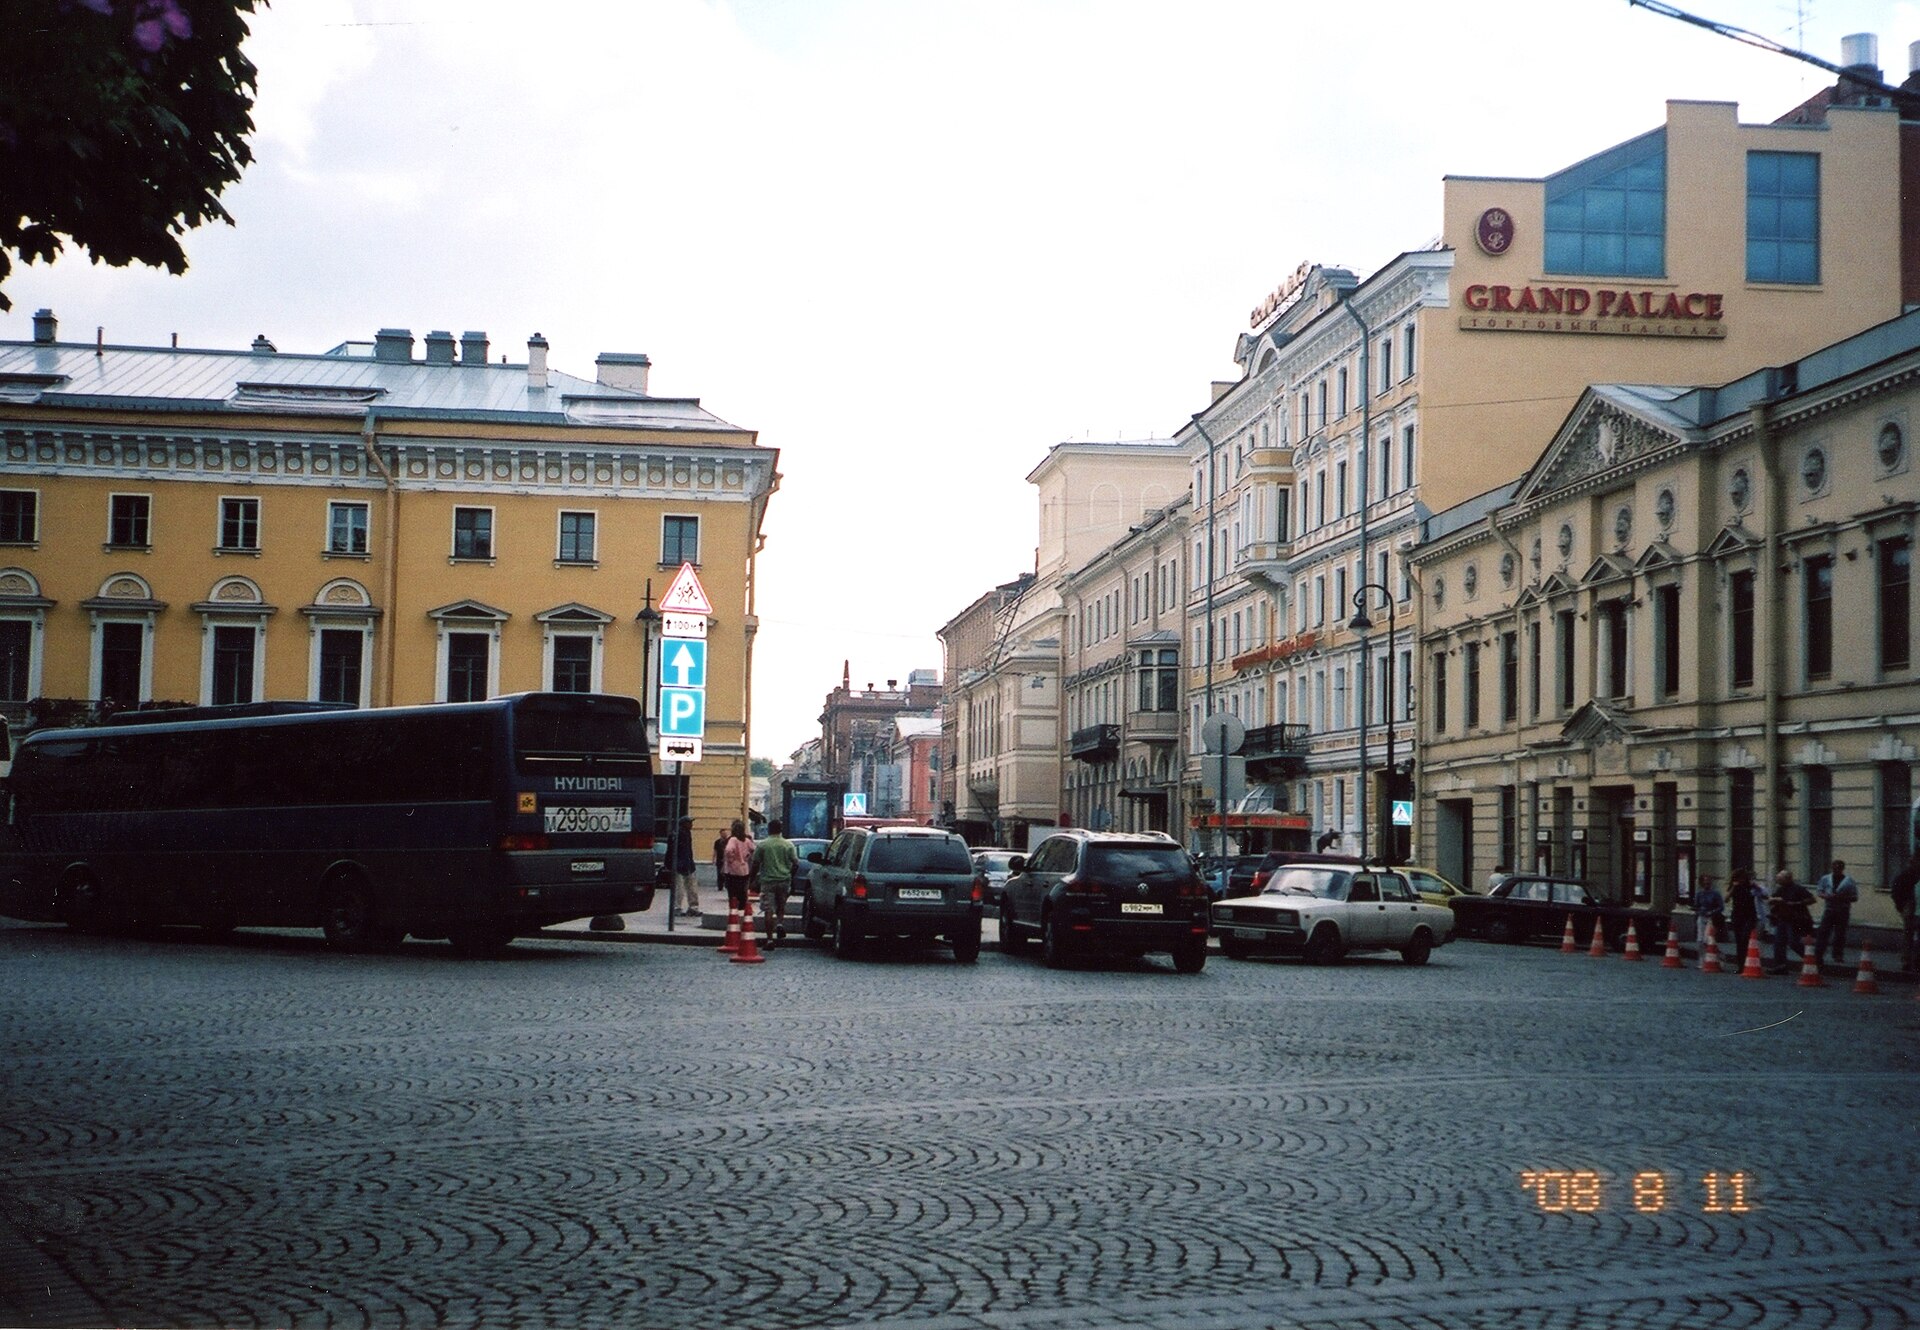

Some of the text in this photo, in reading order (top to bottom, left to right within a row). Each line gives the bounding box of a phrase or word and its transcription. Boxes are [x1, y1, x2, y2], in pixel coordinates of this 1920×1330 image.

[1464, 284, 1724, 320] GRAND PALACE
[1472, 318, 1718, 335] ТОРГОВЫЙ ПАССАЖ
[670, 693, 696, 731] P
[555, 776, 622, 790] HYUNDAI
